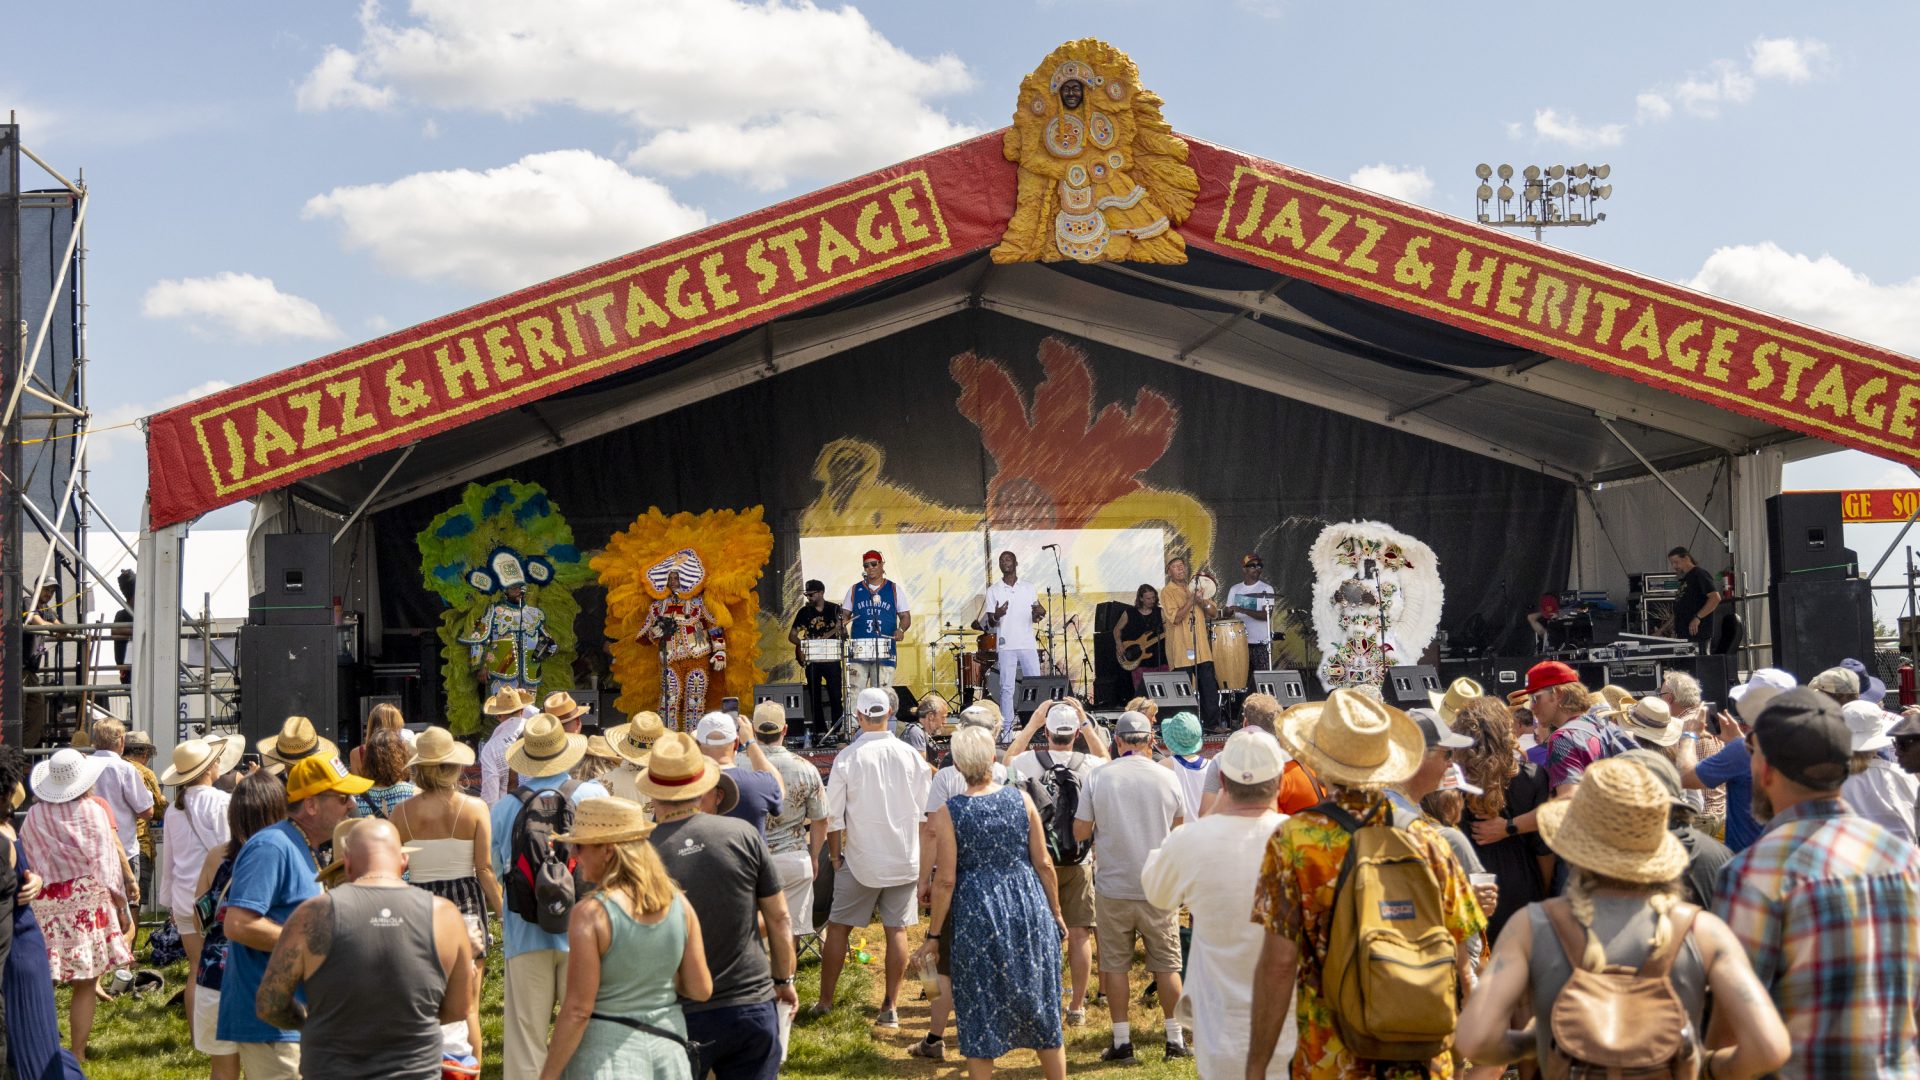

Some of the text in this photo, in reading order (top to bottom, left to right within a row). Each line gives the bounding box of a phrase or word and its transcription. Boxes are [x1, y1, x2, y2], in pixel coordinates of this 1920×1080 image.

[224, 188, 928, 479] JAZZ & HERITAGE STAGE
[1237, 187, 1920, 437] JAZZ & HERITAGE STAGE
[1842, 491, 1920, 520] GE SQ
